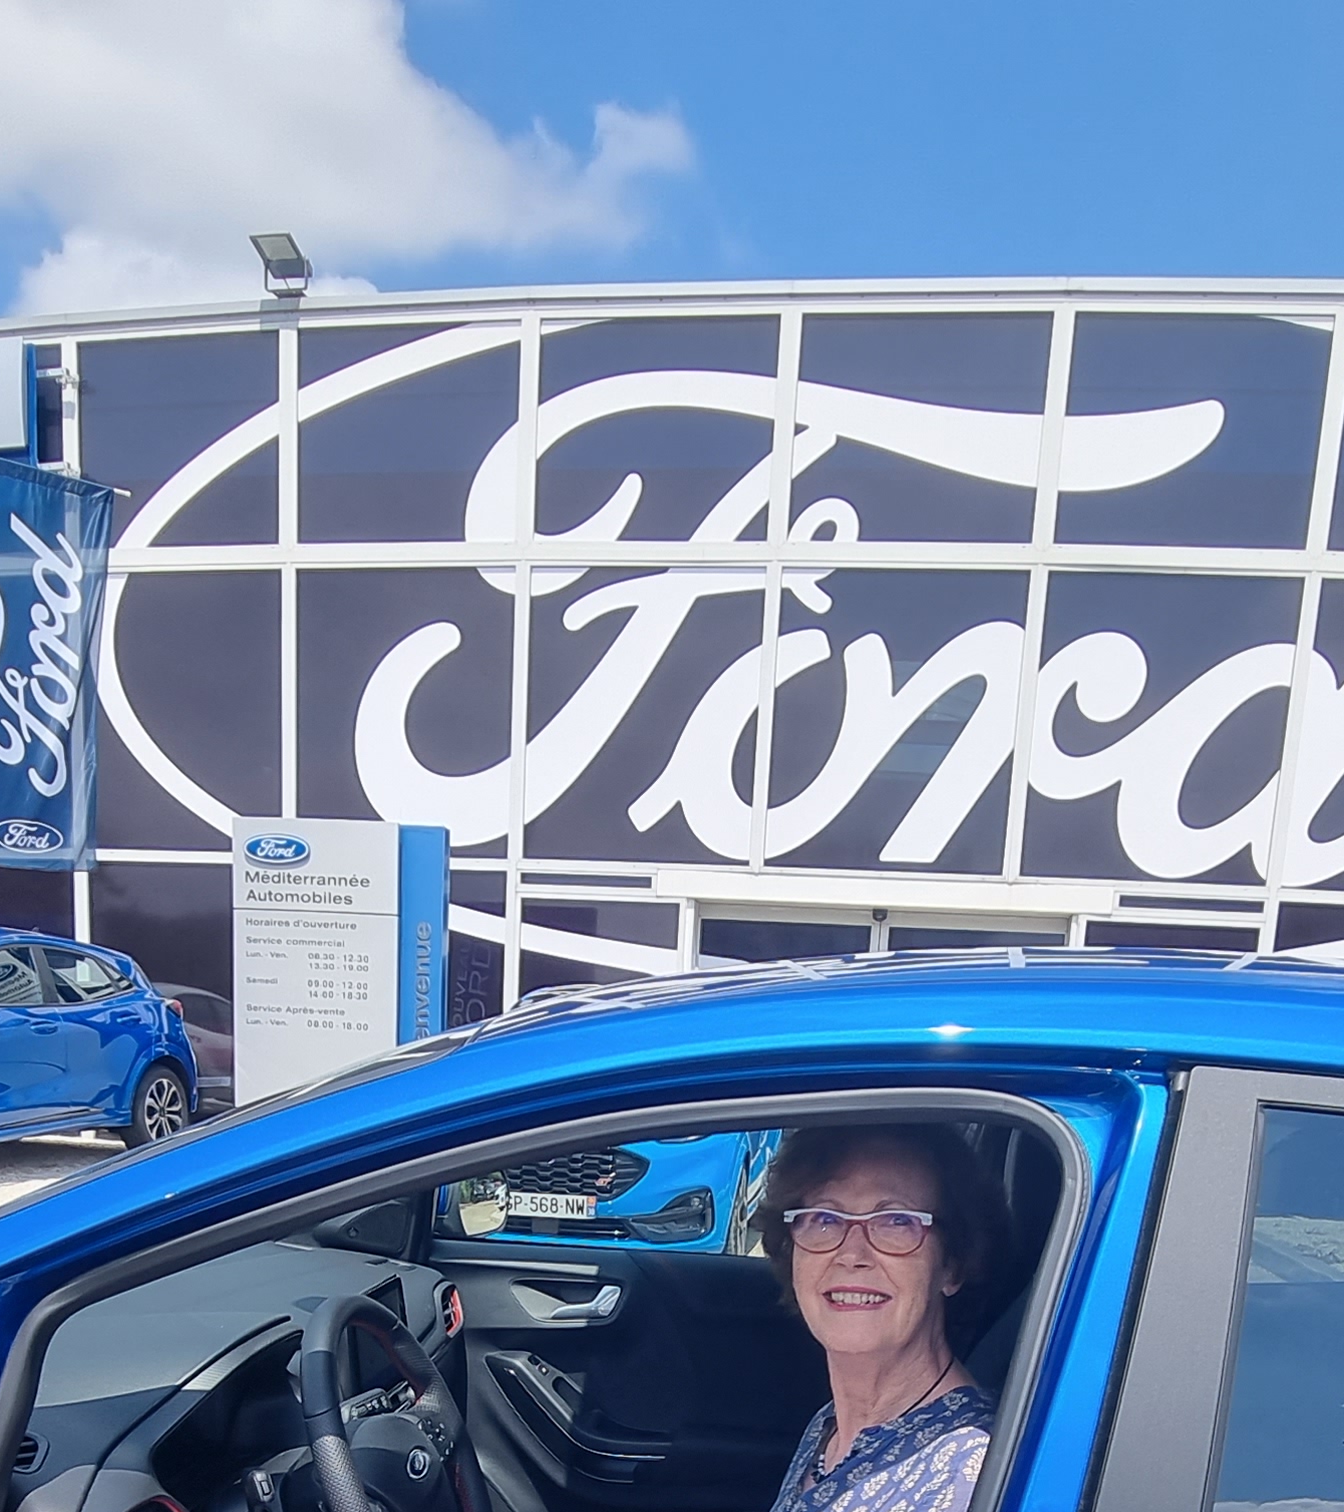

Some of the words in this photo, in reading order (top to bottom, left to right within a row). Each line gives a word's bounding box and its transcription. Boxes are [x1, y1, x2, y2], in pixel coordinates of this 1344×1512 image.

[257, 838, 297, 858] Ford
[244, 870, 371, 888] Méditerrannée
[245, 888, 354, 906] Automobiles
[245, 917, 290, 928] Horaires
[293, 919, 357, 930] d'ouverture
[245, 936, 282, 945] Service
[285, 937, 345, 948] commercial
[245, 976, 279, 985] Samedi
[415, 921, 432, 1041] envenue
[465, 944, 492, 1023] ORD
[246, 1003, 282, 1013] Service
